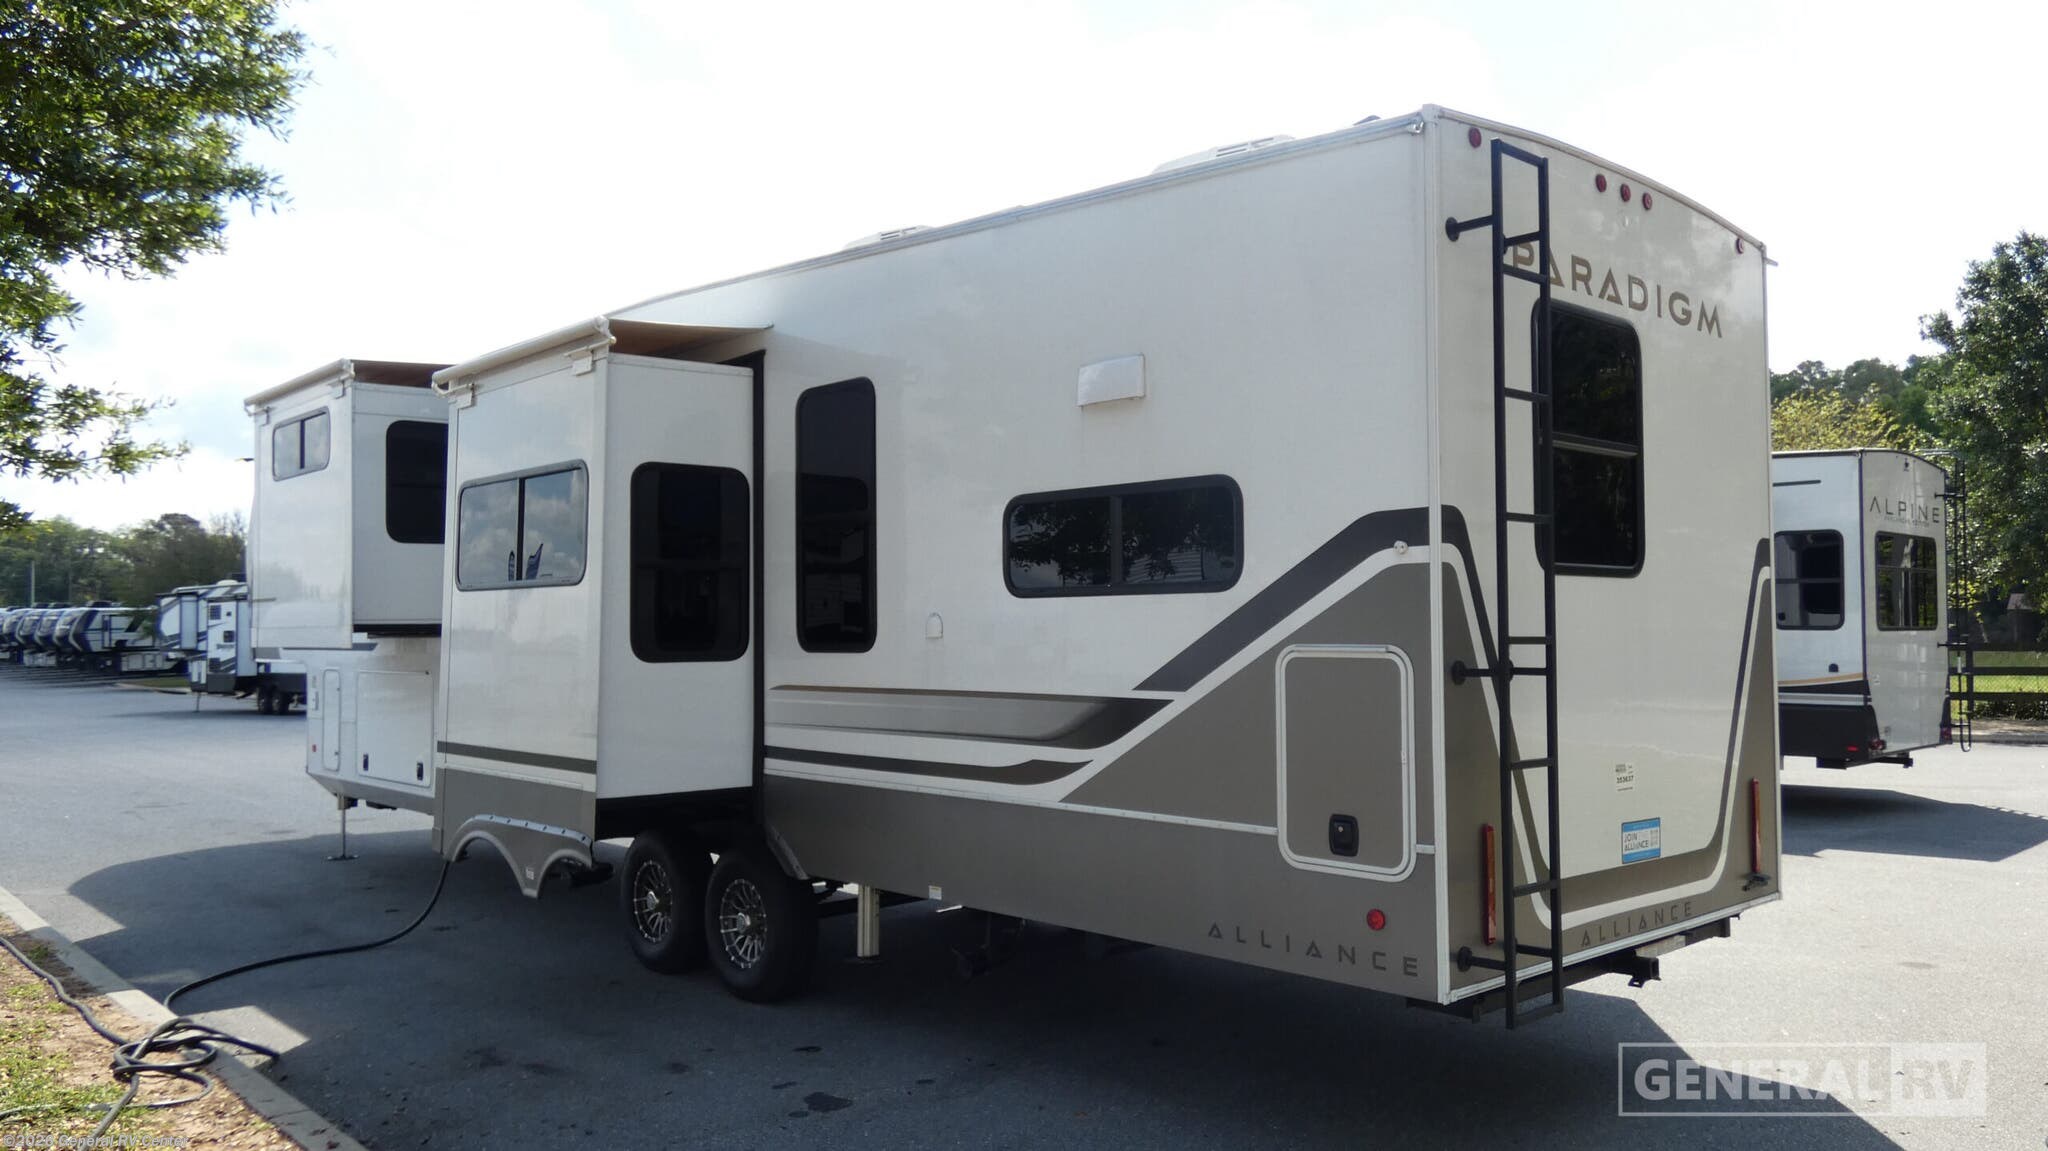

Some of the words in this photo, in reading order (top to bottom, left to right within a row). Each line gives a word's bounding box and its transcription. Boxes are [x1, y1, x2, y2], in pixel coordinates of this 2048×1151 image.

[1511, 241, 1723, 339] PARADIGM
[1869, 495, 1940, 524] ALPINE
[1207, 921, 1419, 978] ALLIANCE
[1580, 901, 1693, 948] ALLIANCE
